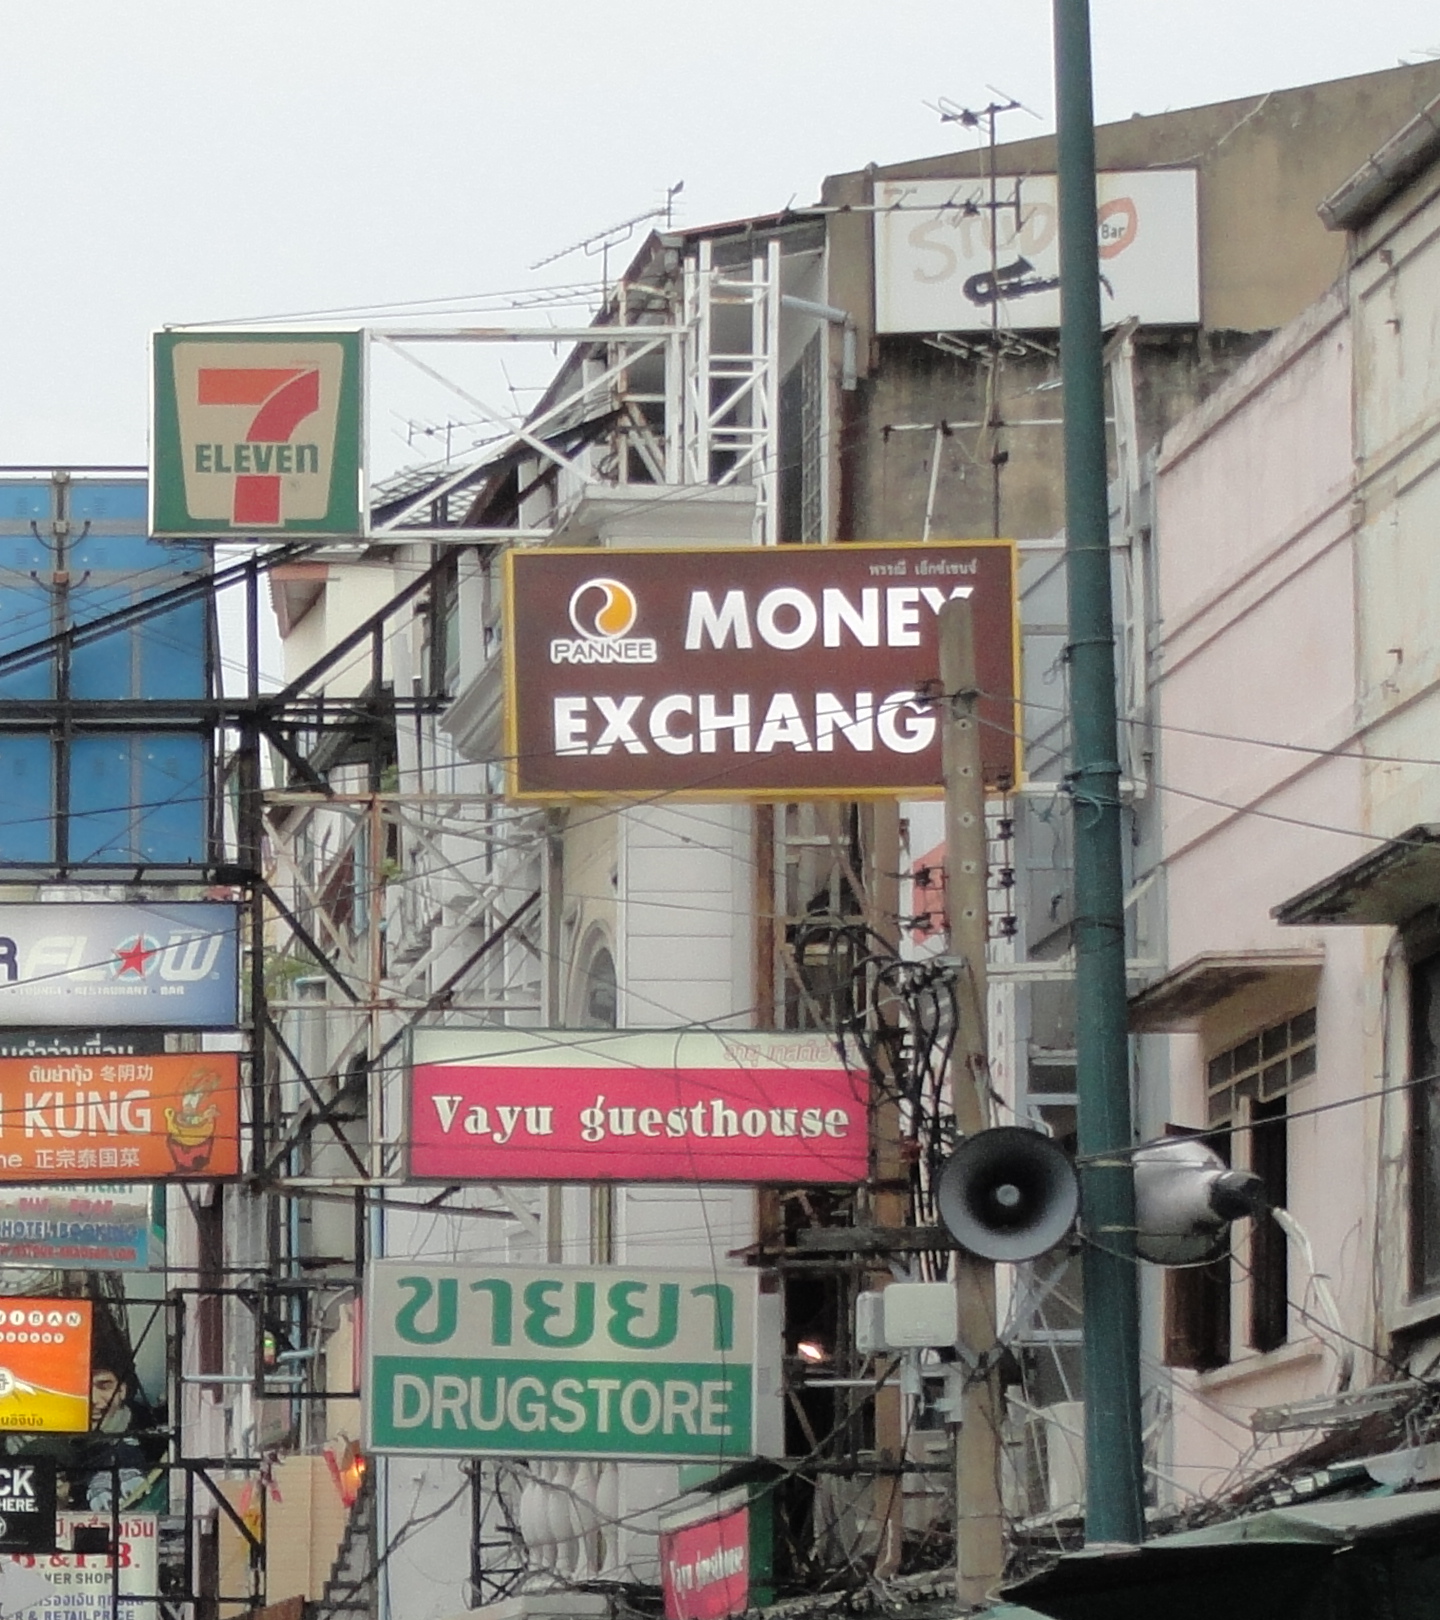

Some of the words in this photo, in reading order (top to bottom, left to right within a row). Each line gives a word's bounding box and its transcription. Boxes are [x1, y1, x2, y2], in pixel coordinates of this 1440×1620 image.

[1101, 223, 1126, 240] Bar
[553, 640, 655, 662] PANNEE
[552, 690, 938, 757] EXCHANG
[73, 986, 150, 996] RESTAURANT
[159, 985, 185, 995] BAR
[24, 1089, 153, 1138] KUNG
[431, 1095, 553, 1144] Vayu
[579, 1094, 850, 1143] guesthouse
[35, 1148, 141, 1169] 正宗泰国菜
[0, 1219, 54, 1240] HOTEL
[393, 1275, 736, 1352] ขายยา
[392, 1373, 733, 1436] DRUGSTORE
[76, 1573, 115, 1586] SHOP
